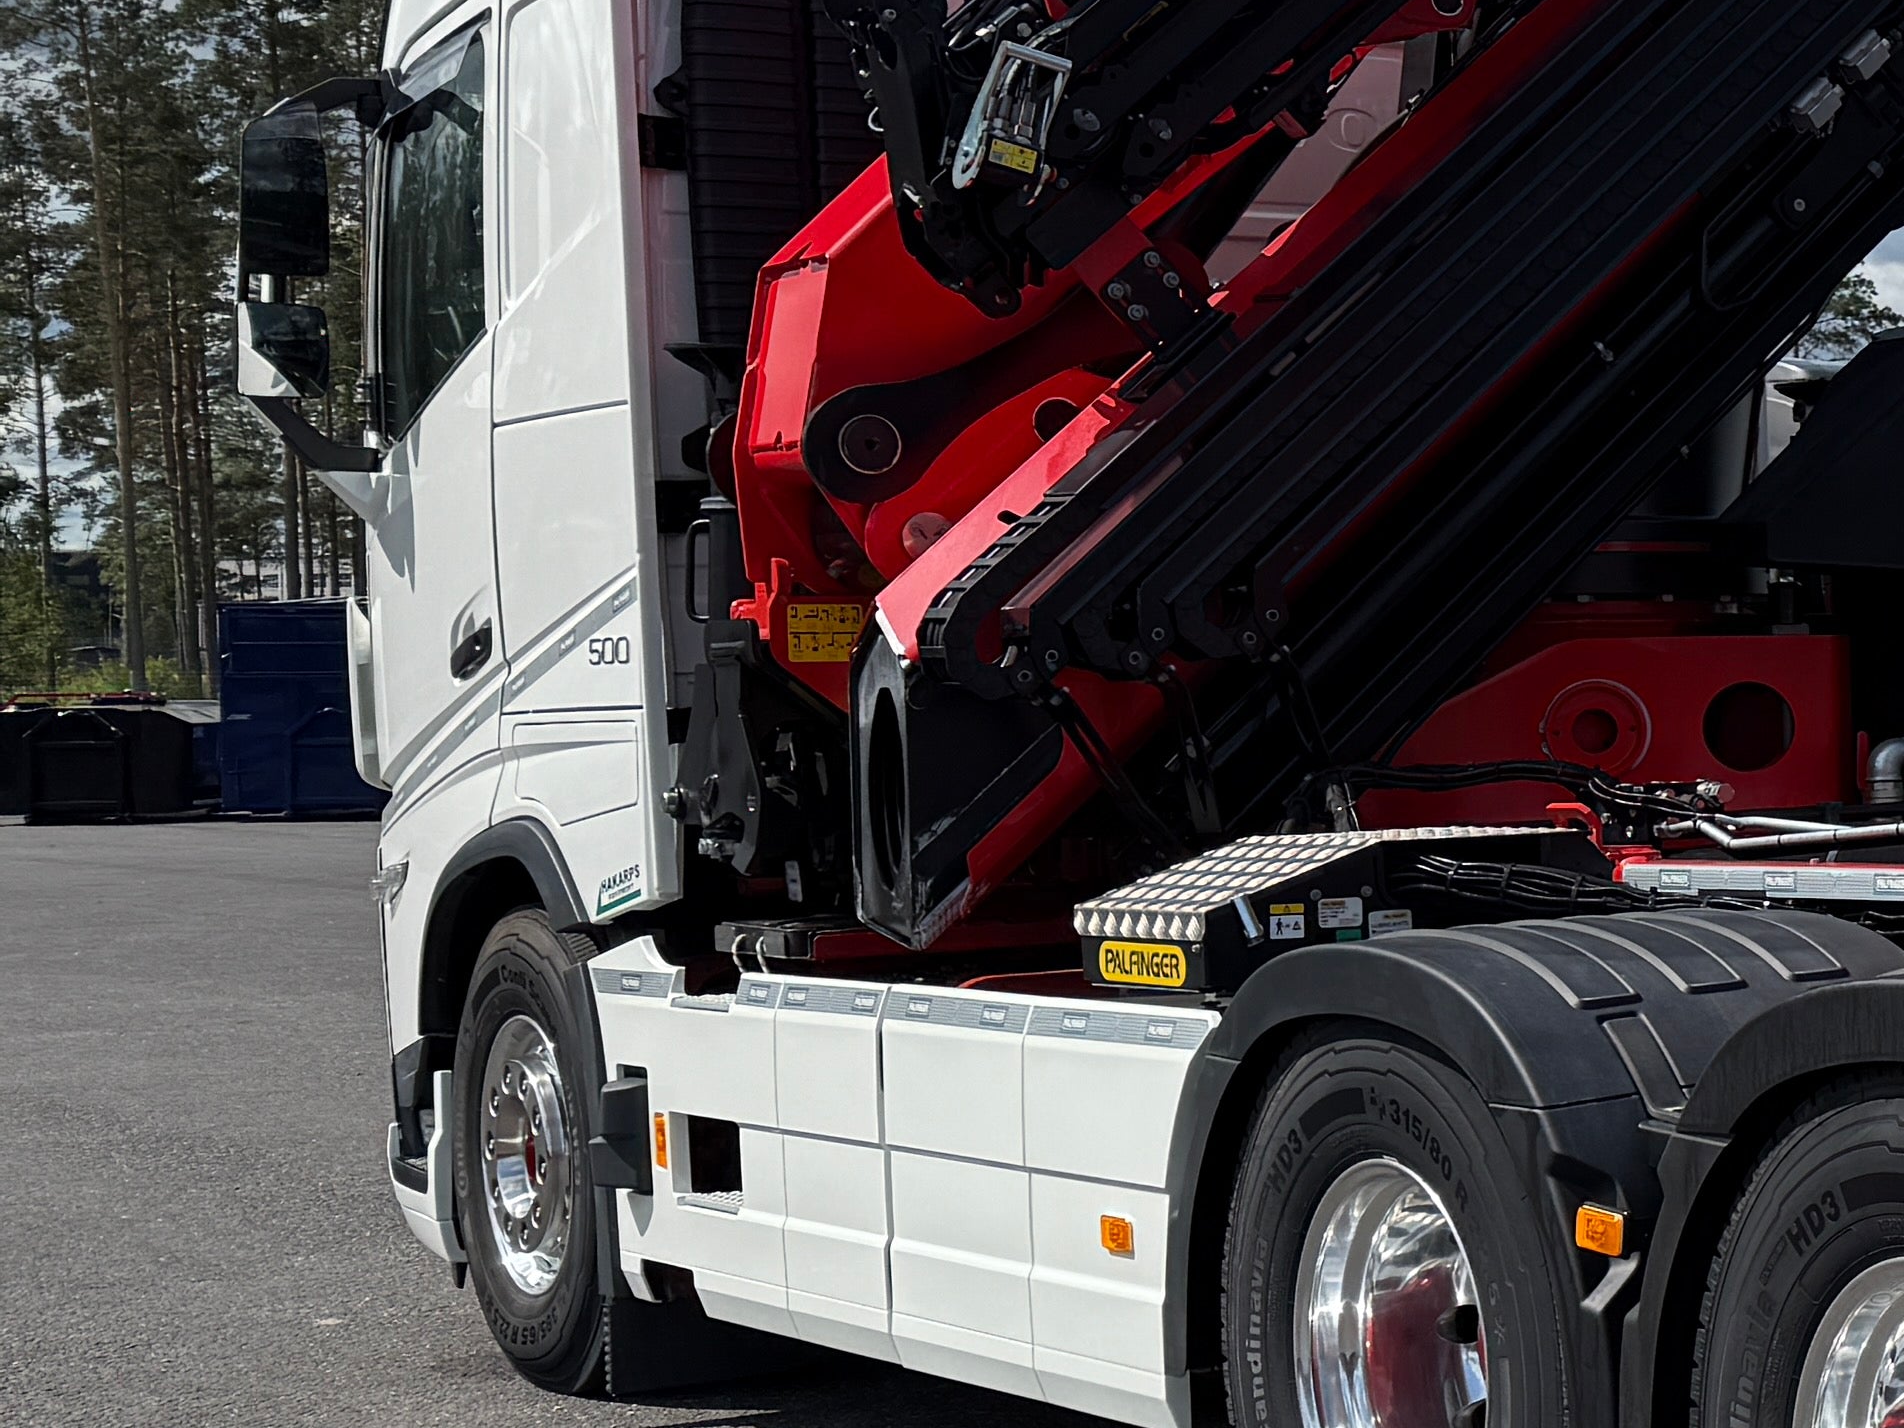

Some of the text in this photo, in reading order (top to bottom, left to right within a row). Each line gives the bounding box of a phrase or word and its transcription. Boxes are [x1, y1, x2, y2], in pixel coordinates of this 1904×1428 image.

[588, 636, 630, 665] 500
[1104, 948, 1180, 980] PALFINGER
[1271, 1129, 1302, 1194] HD3
[1390, 1099, 1452, 1181] 315/80
[1786, 1189, 1843, 1260] HD3
